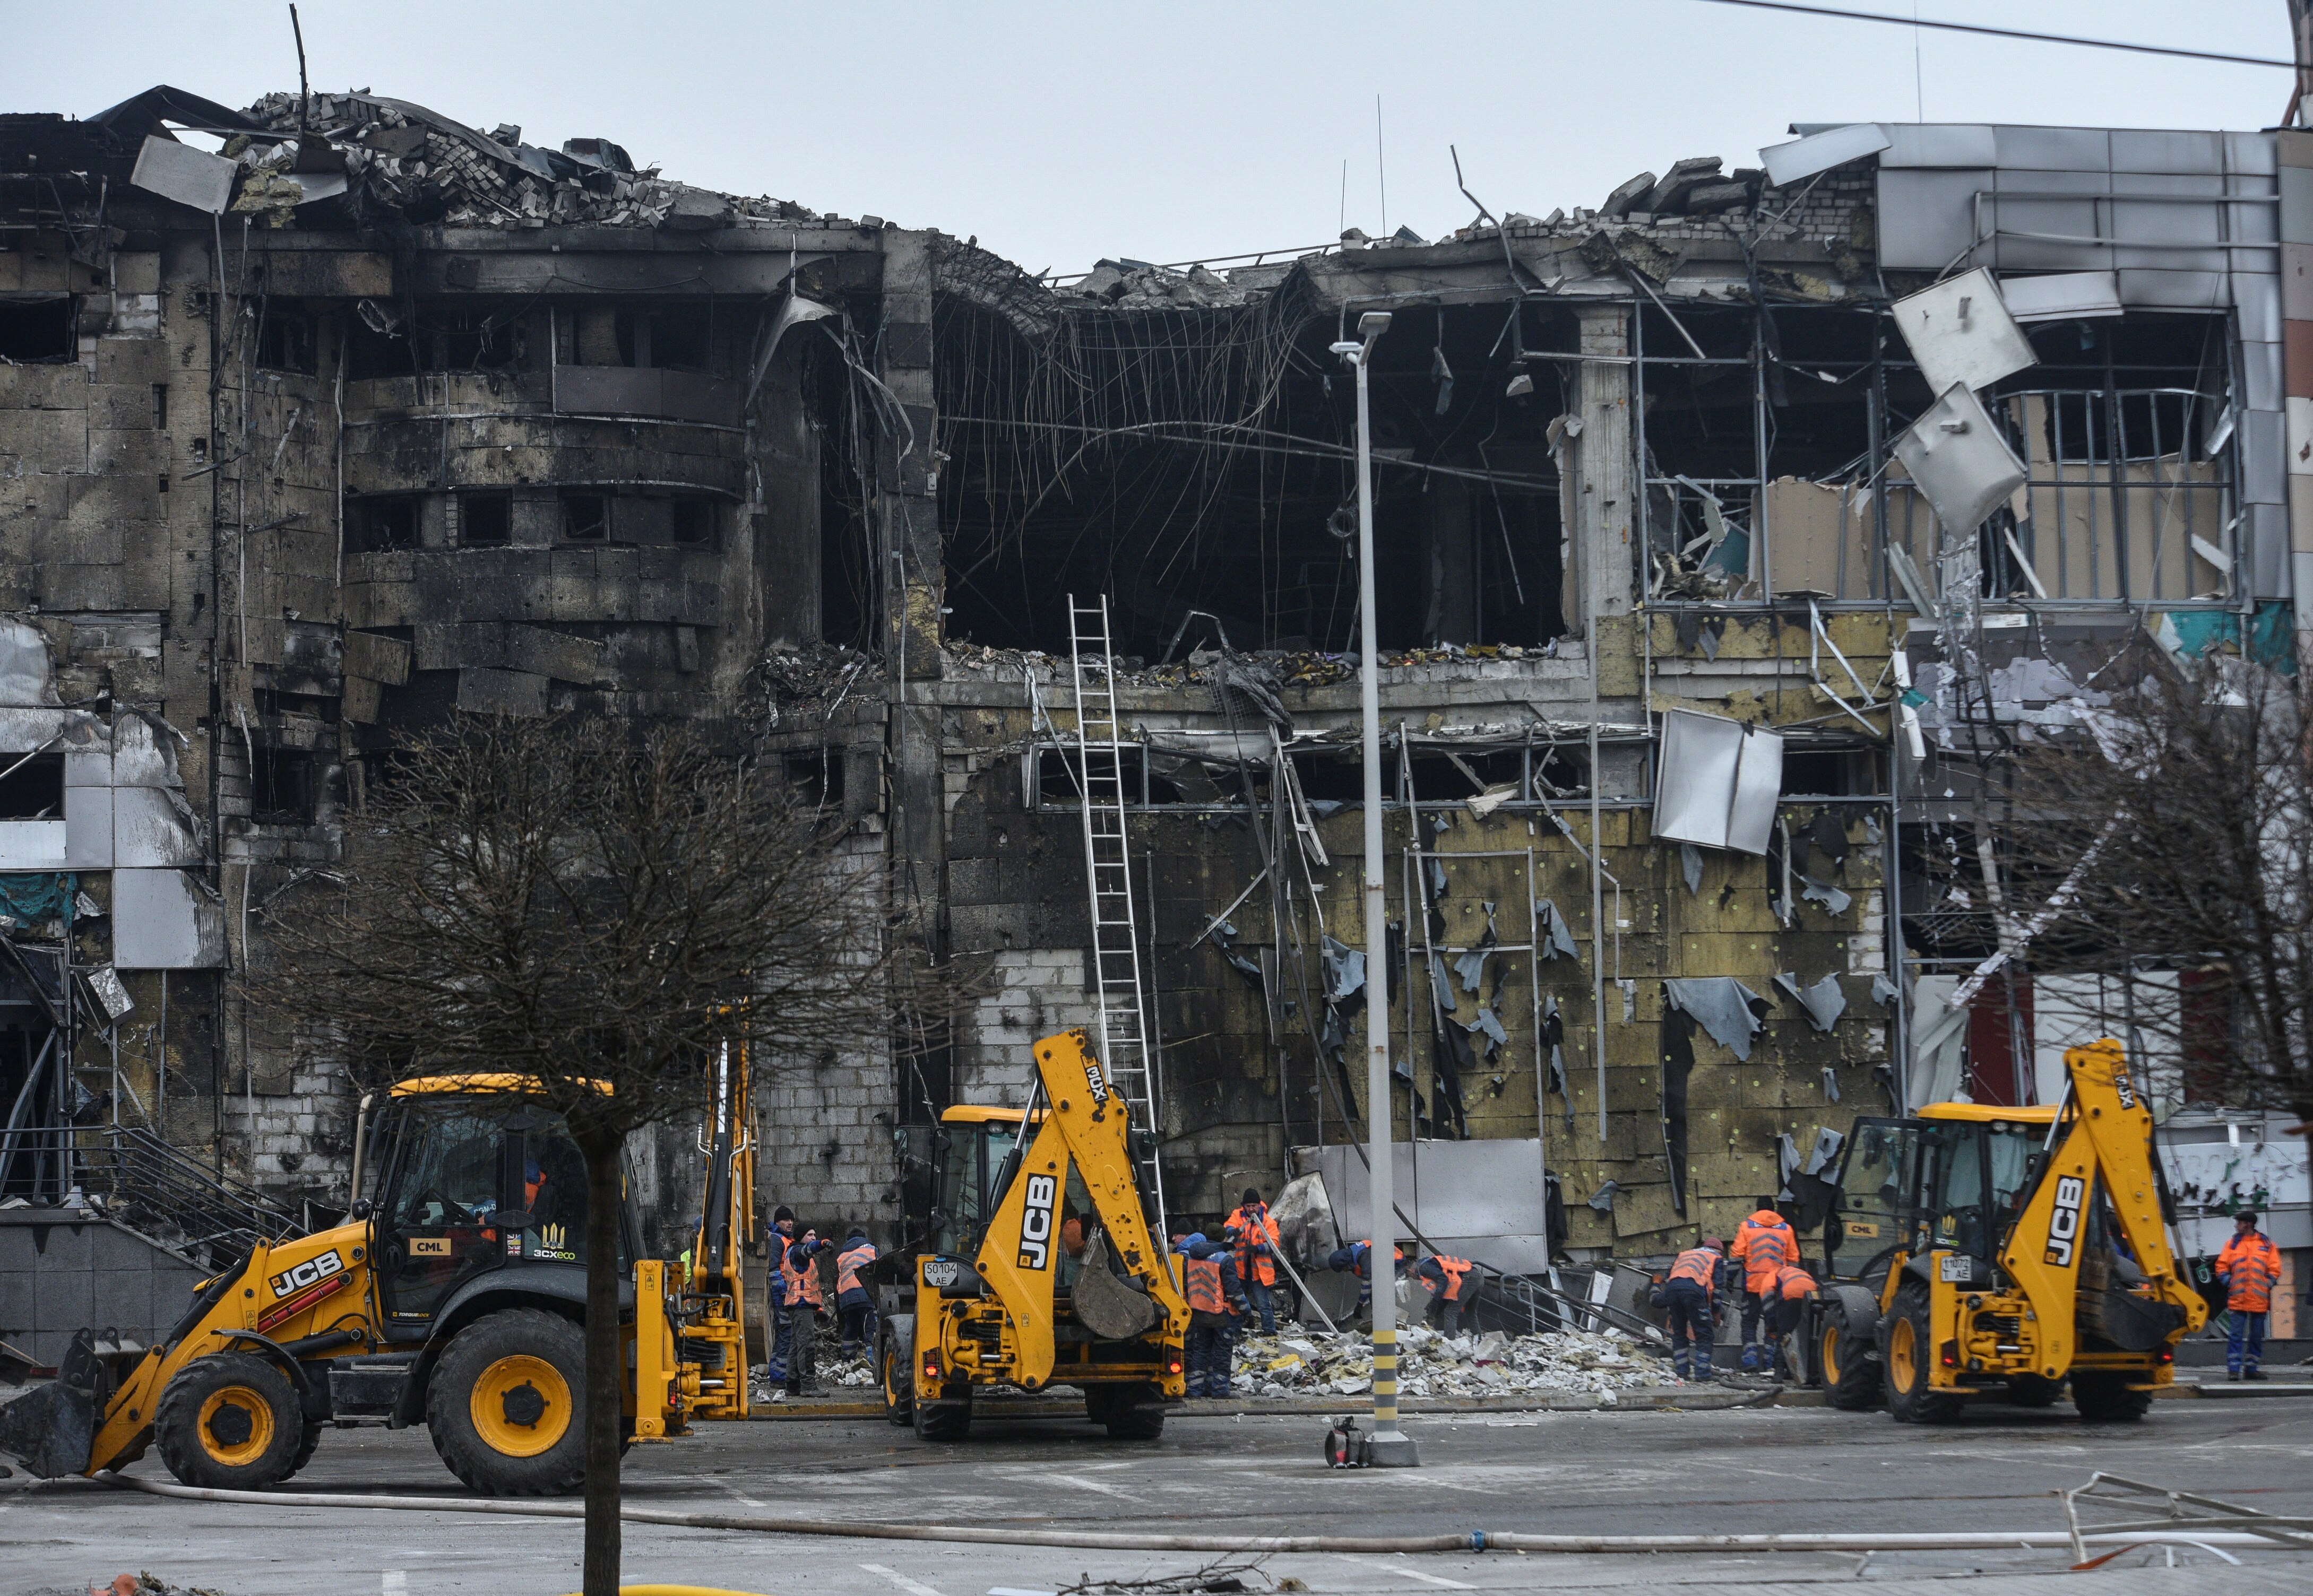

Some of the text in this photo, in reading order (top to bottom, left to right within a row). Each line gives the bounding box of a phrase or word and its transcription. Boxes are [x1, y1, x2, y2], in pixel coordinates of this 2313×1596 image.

[1086, 1066, 1107, 1099] 3CX
[1021, 1176, 1054, 1268] JCB
[2048, 1178, 2083, 1265] JCB
[417, 1242, 443, 1252] CML
[533, 1250, 575, 1260] 3CXeco
[275, 1252, 342, 1296] JCB
[927, 1264, 956, 1273] 50104
